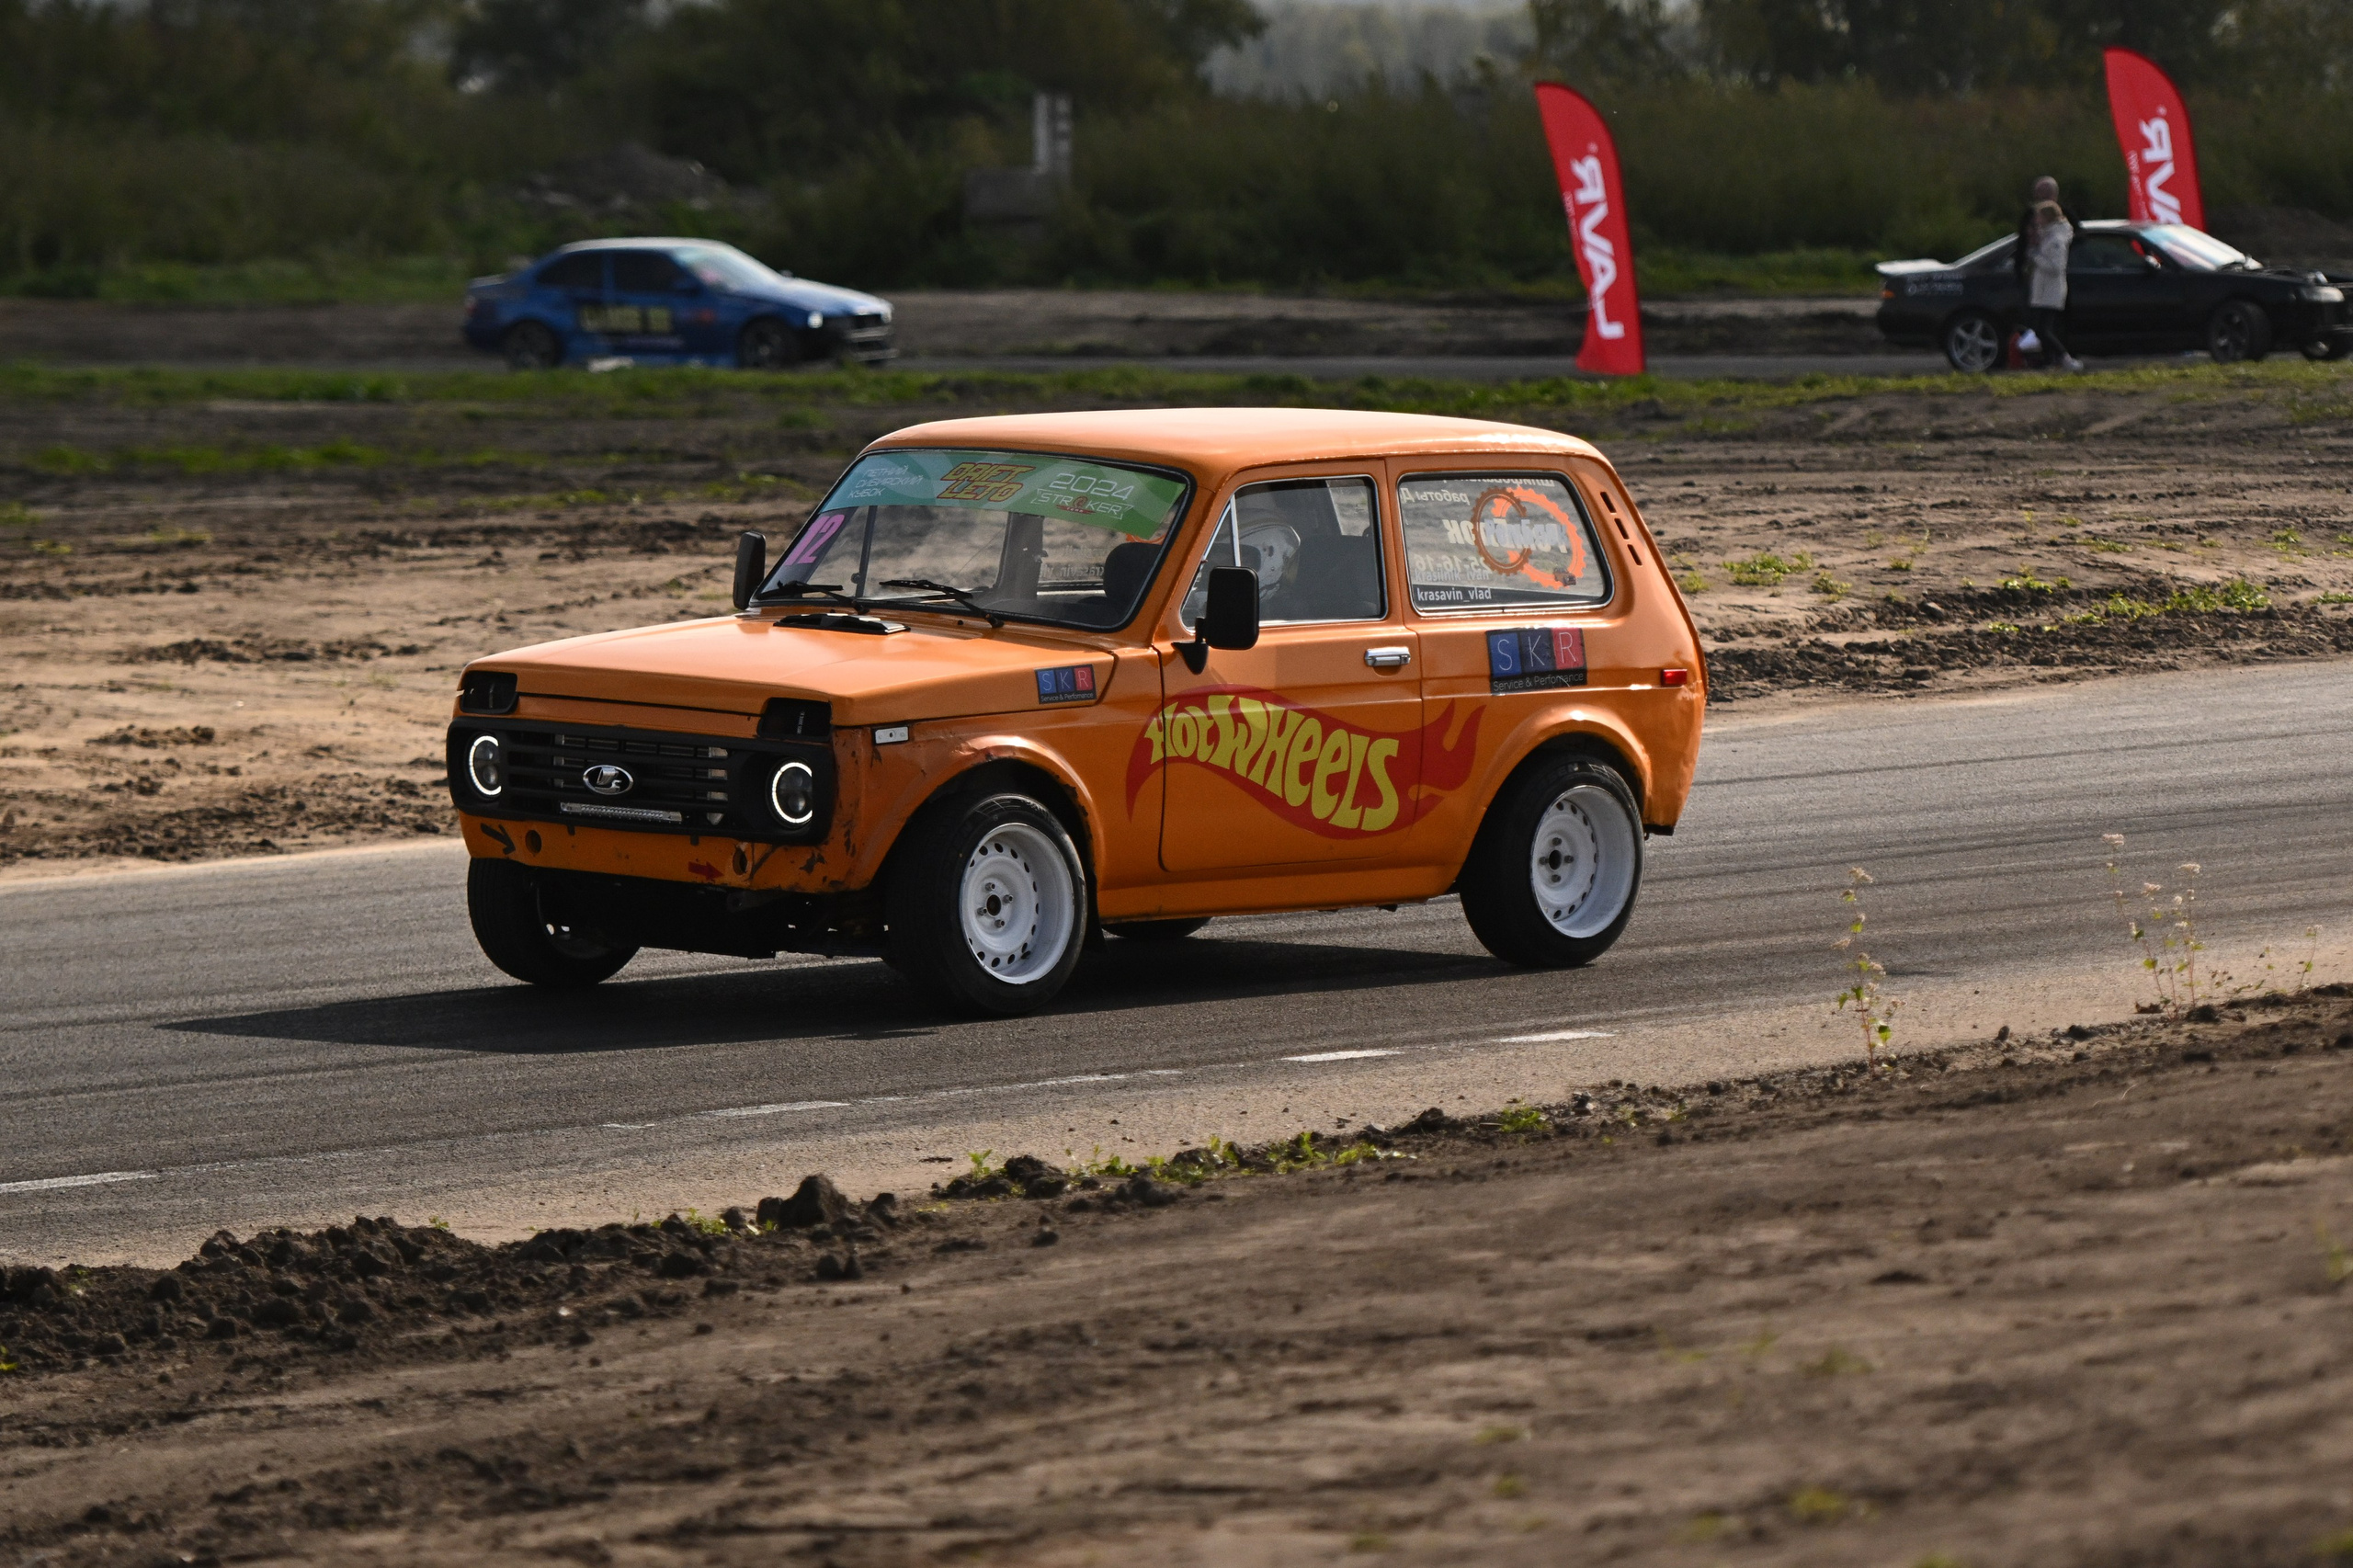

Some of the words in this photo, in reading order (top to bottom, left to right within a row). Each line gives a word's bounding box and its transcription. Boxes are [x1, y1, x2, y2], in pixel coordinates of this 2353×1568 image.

[941, 460, 1037, 483] DRIFT
[937, 480, 1024, 503] LETO
[1049, 472, 1135, 500] 2024
[784, 513, 846, 566] 12
[1416, 586, 1493, 603] krasavin_vlad
[1497, 631, 1576, 671] SKR
[1042, 671, 1088, 690] SKR
[1493, 680, 1525, 691] Service
[1525, 676, 1532, 687] &
